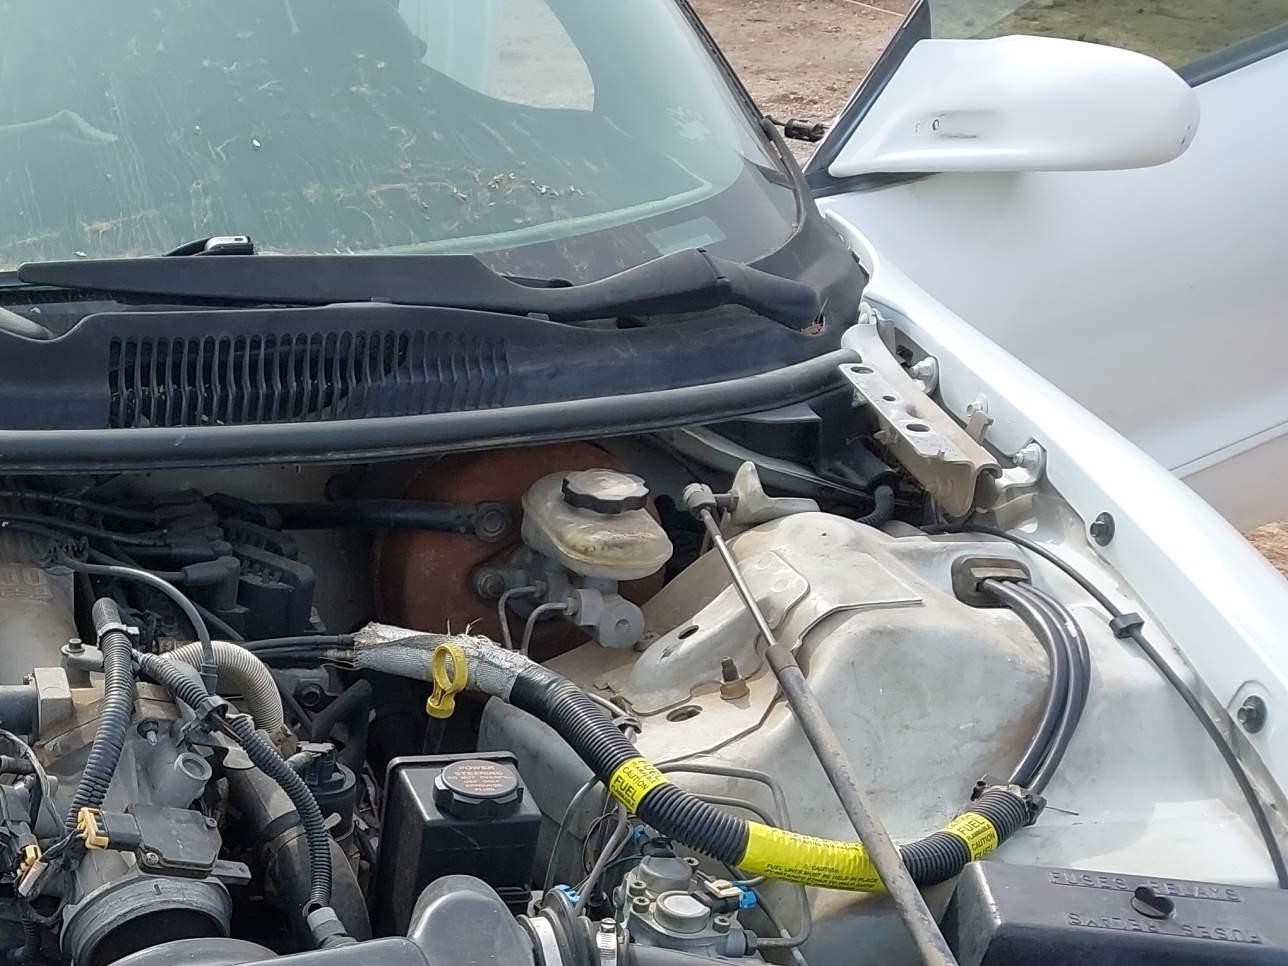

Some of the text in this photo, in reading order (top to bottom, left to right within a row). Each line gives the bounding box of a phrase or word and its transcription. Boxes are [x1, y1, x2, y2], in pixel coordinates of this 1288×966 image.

[613, 774, 637, 802] FUEL
[971, 832, 996, 851] CAUTION
[812, 865, 839, 873] CAUTION
[1048, 871, 1129, 890] FUSES
